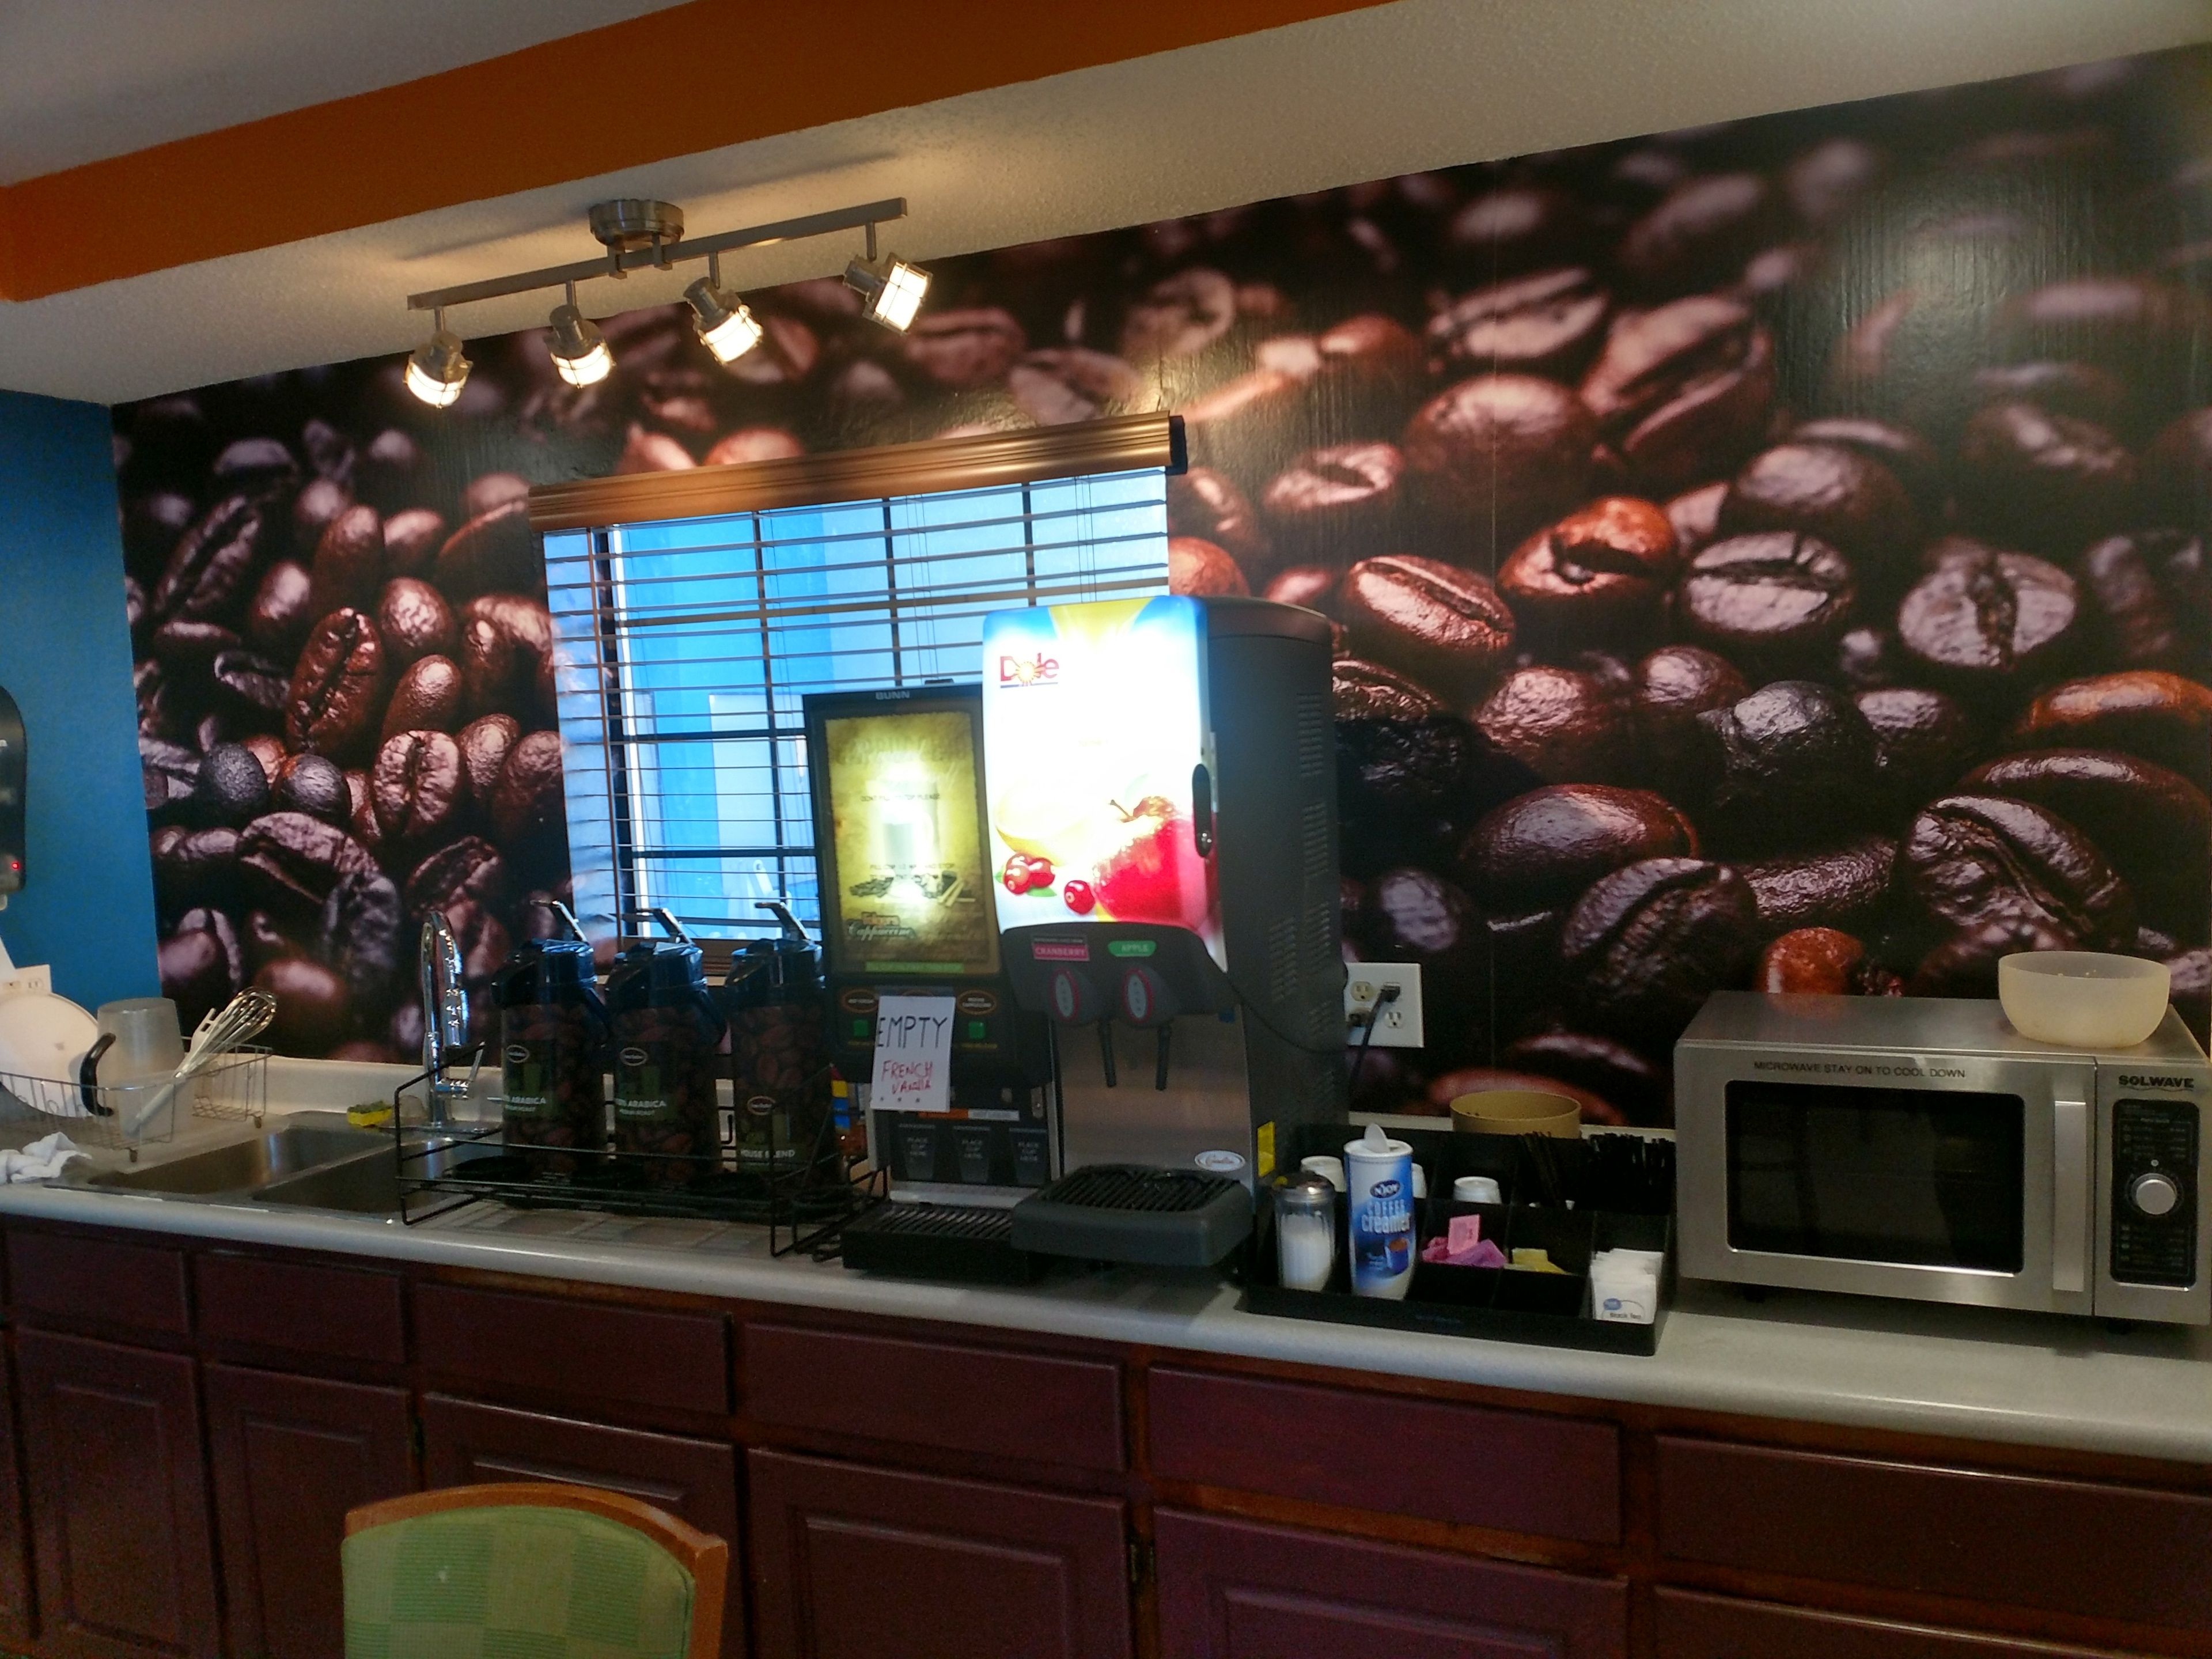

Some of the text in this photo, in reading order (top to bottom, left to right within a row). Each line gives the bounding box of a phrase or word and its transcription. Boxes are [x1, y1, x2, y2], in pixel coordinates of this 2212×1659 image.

[1000, 652, 1059, 681] Dole
[875, 691, 910, 700] BUNN
[1035, 945, 1086, 957] CRANBERRY
[1121, 943, 1149, 953] APPLE
[877, 1016, 948, 1049] EMPTY
[881, 1059, 933, 1082] FRENCH
[1753, 1060, 1966, 1078] MICROWAVE STAY ON TO COOL DOWN
[2118, 1074, 2194, 1089] SOLWAVE
[1361, 1212, 1411, 1234] creamer
